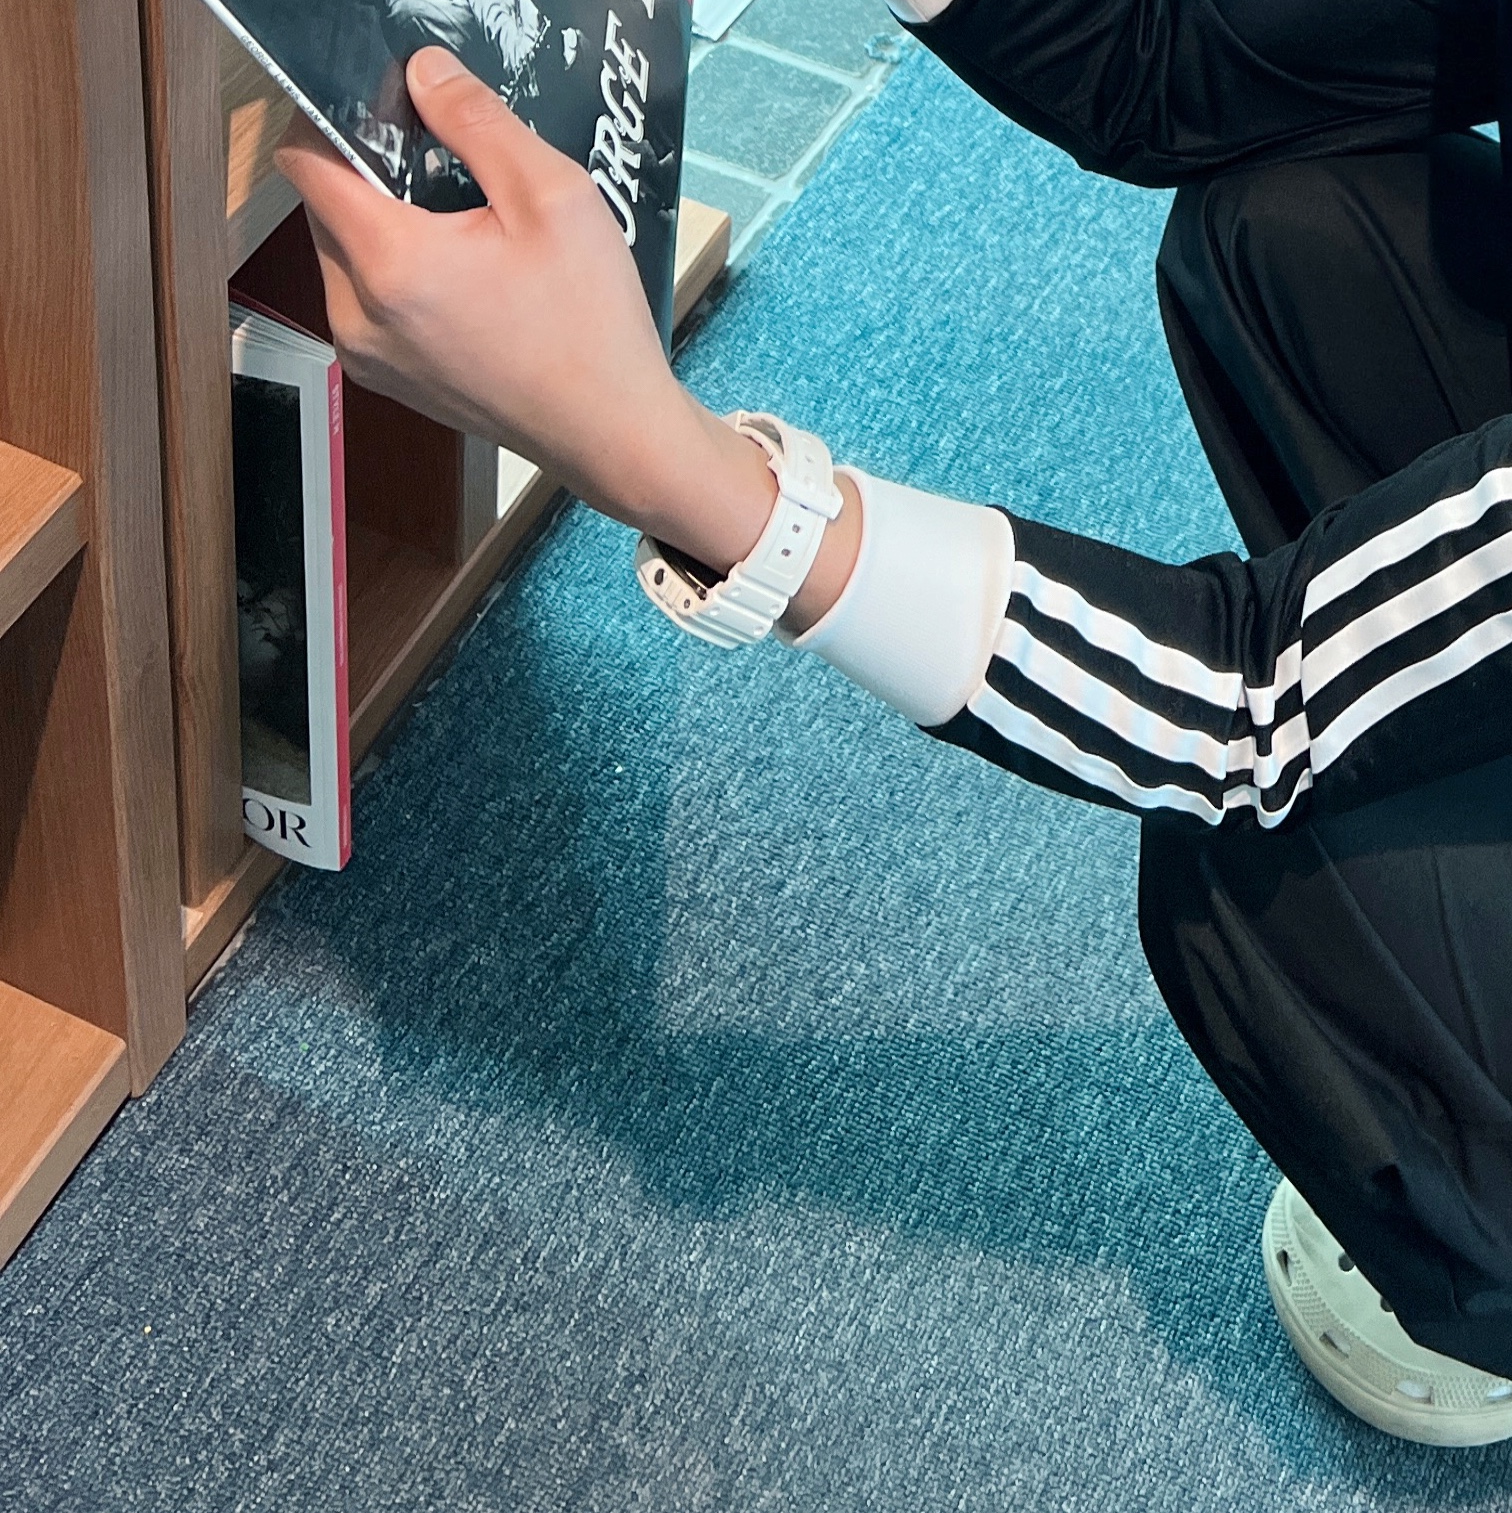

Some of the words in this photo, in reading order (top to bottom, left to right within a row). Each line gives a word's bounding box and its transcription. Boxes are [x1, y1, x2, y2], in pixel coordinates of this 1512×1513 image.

[241, 35, 274, 69] GEORGE
[273, 72, 300, 101] LEWIS
[302, 105, 321, 124] JAM
[322, 125, 356, 161] SESSION
[589, 9, 650, 247] ORGE
